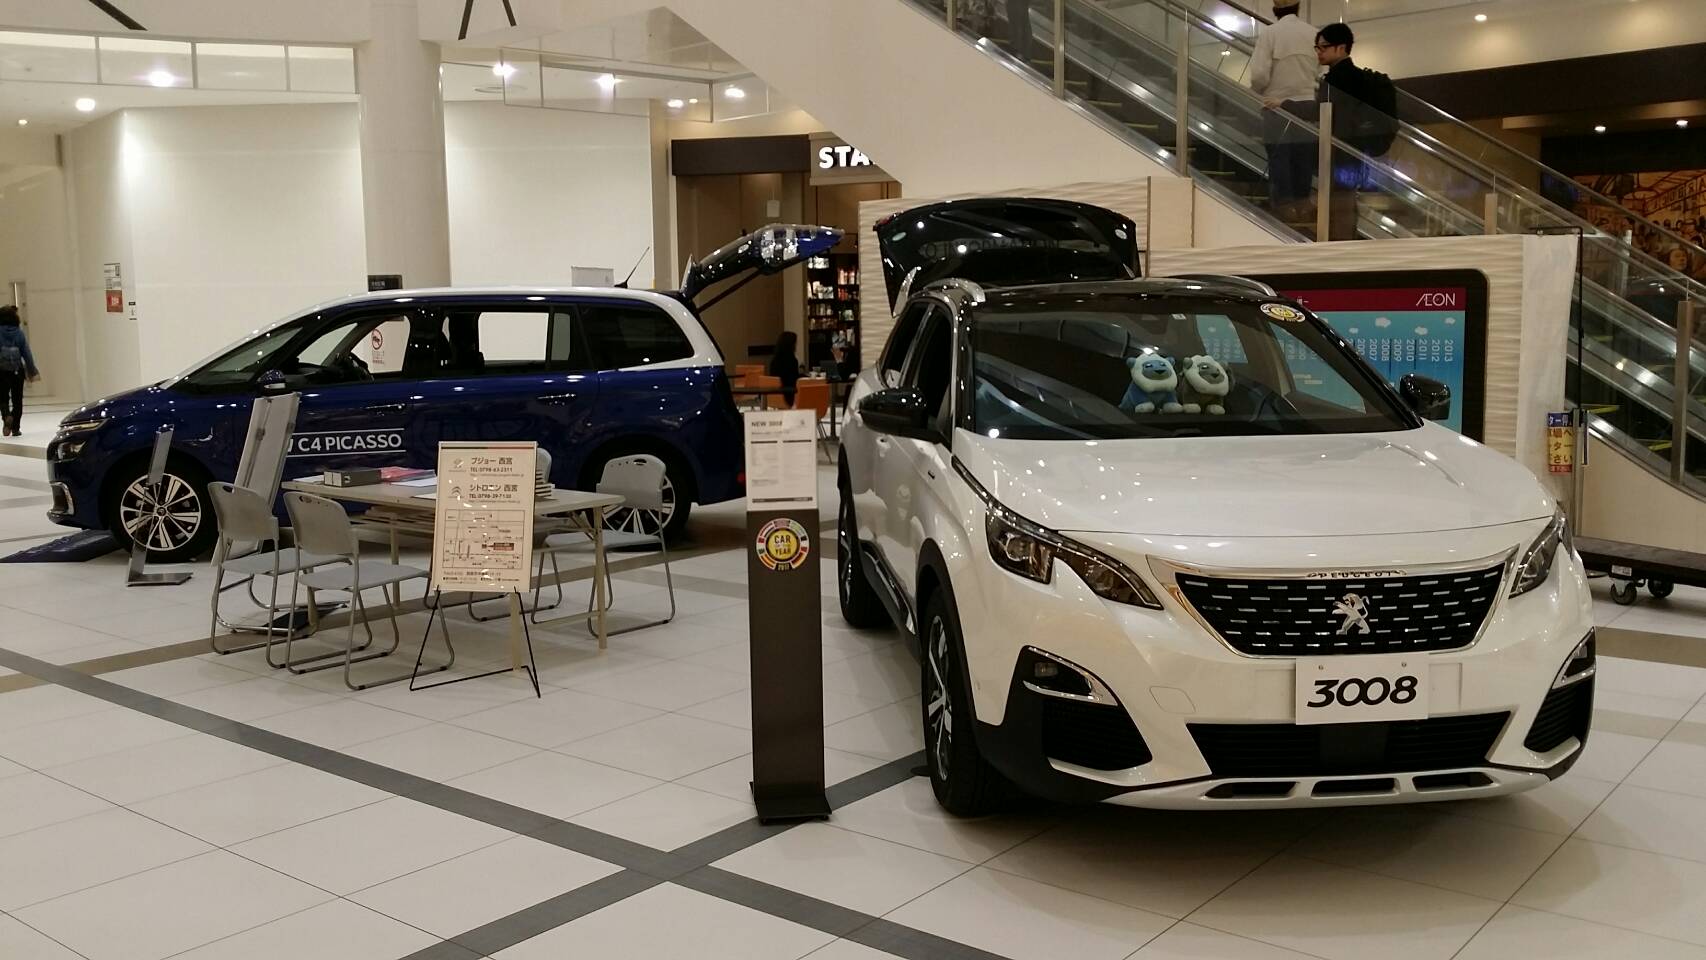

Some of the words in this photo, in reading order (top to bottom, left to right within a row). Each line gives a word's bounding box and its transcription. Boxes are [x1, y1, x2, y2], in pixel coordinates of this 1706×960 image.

[819, 145, 875, 169] STA
[1369, 339, 1377, 361] 2007
[1381, 339, 1390, 361] 2008
[1393, 339, 1402, 362] 2009
[1406, 339, 1415, 362] 2010
[1418, 339, 1428, 361] 2011
[1431, 339, 1440, 362] 2012
[1444, 340, 1454, 362] 2013
[298, 437, 321, 452] C4
[325, 433, 402, 451] PICASSO
[774, 535, 791, 544] CAR
[1307, 675, 1418, 708] 3008
